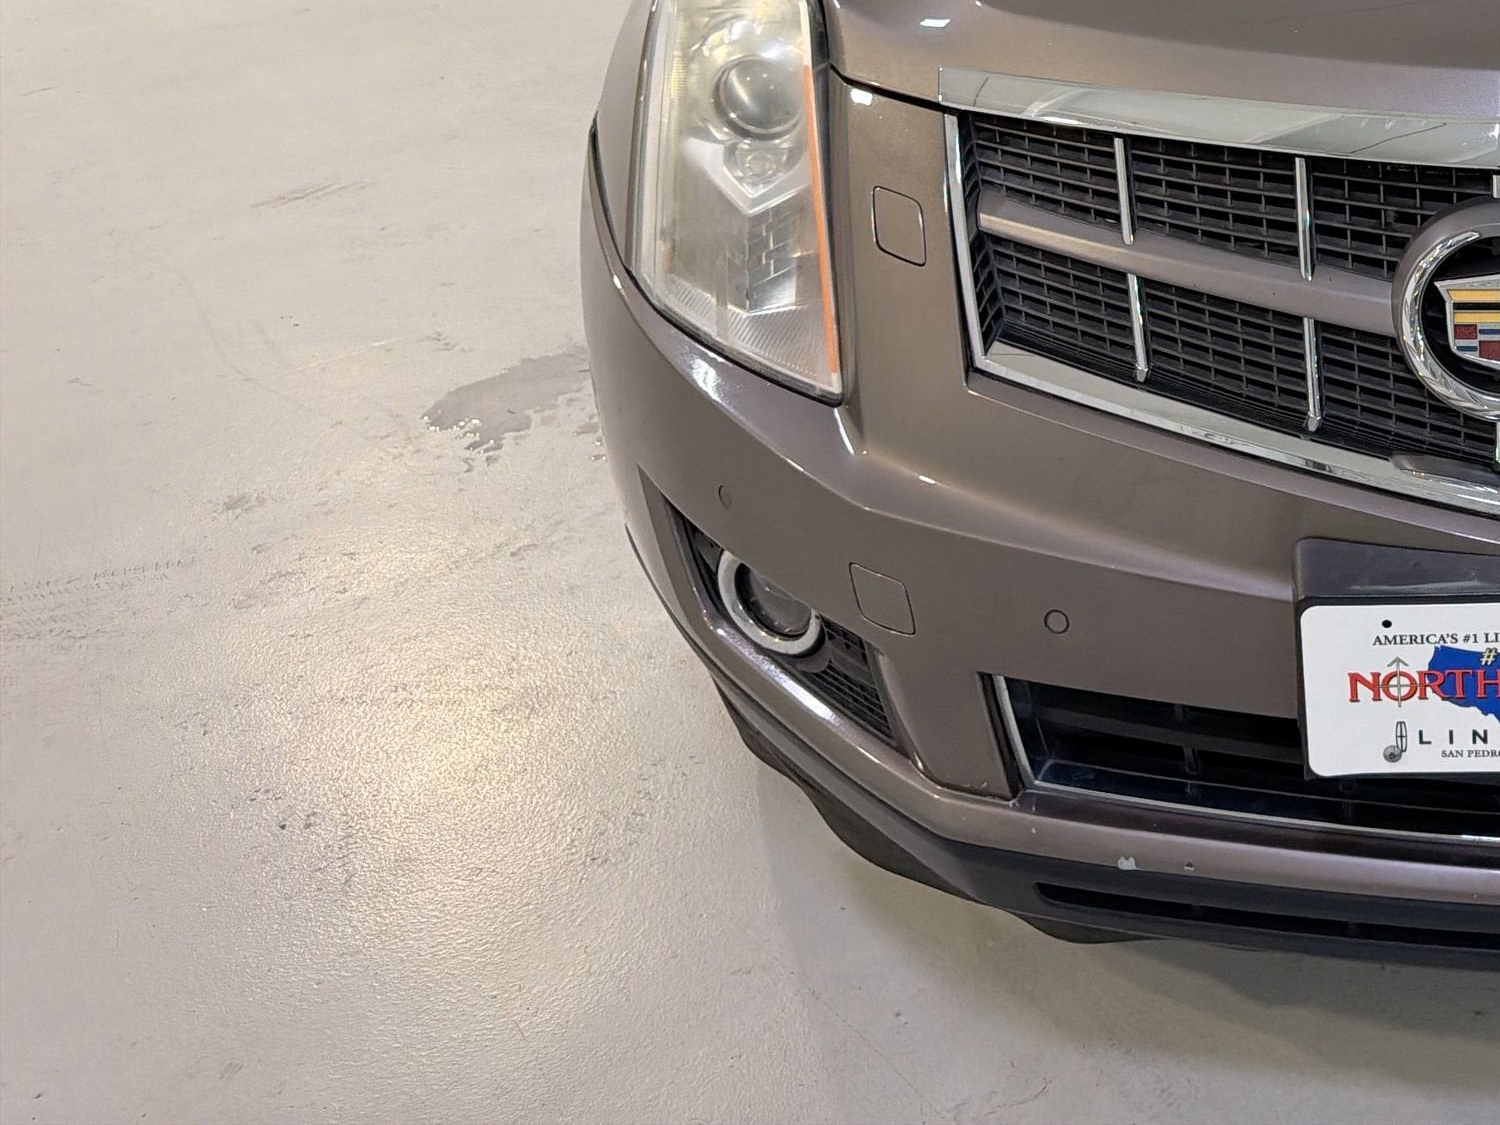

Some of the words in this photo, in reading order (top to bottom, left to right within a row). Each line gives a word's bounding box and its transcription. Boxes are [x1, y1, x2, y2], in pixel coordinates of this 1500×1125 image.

[1372, 632, 1459, 646] AMERICA'S
[1462, 631, 1479, 644] #1
[1440, 748, 1463, 758] SAN
